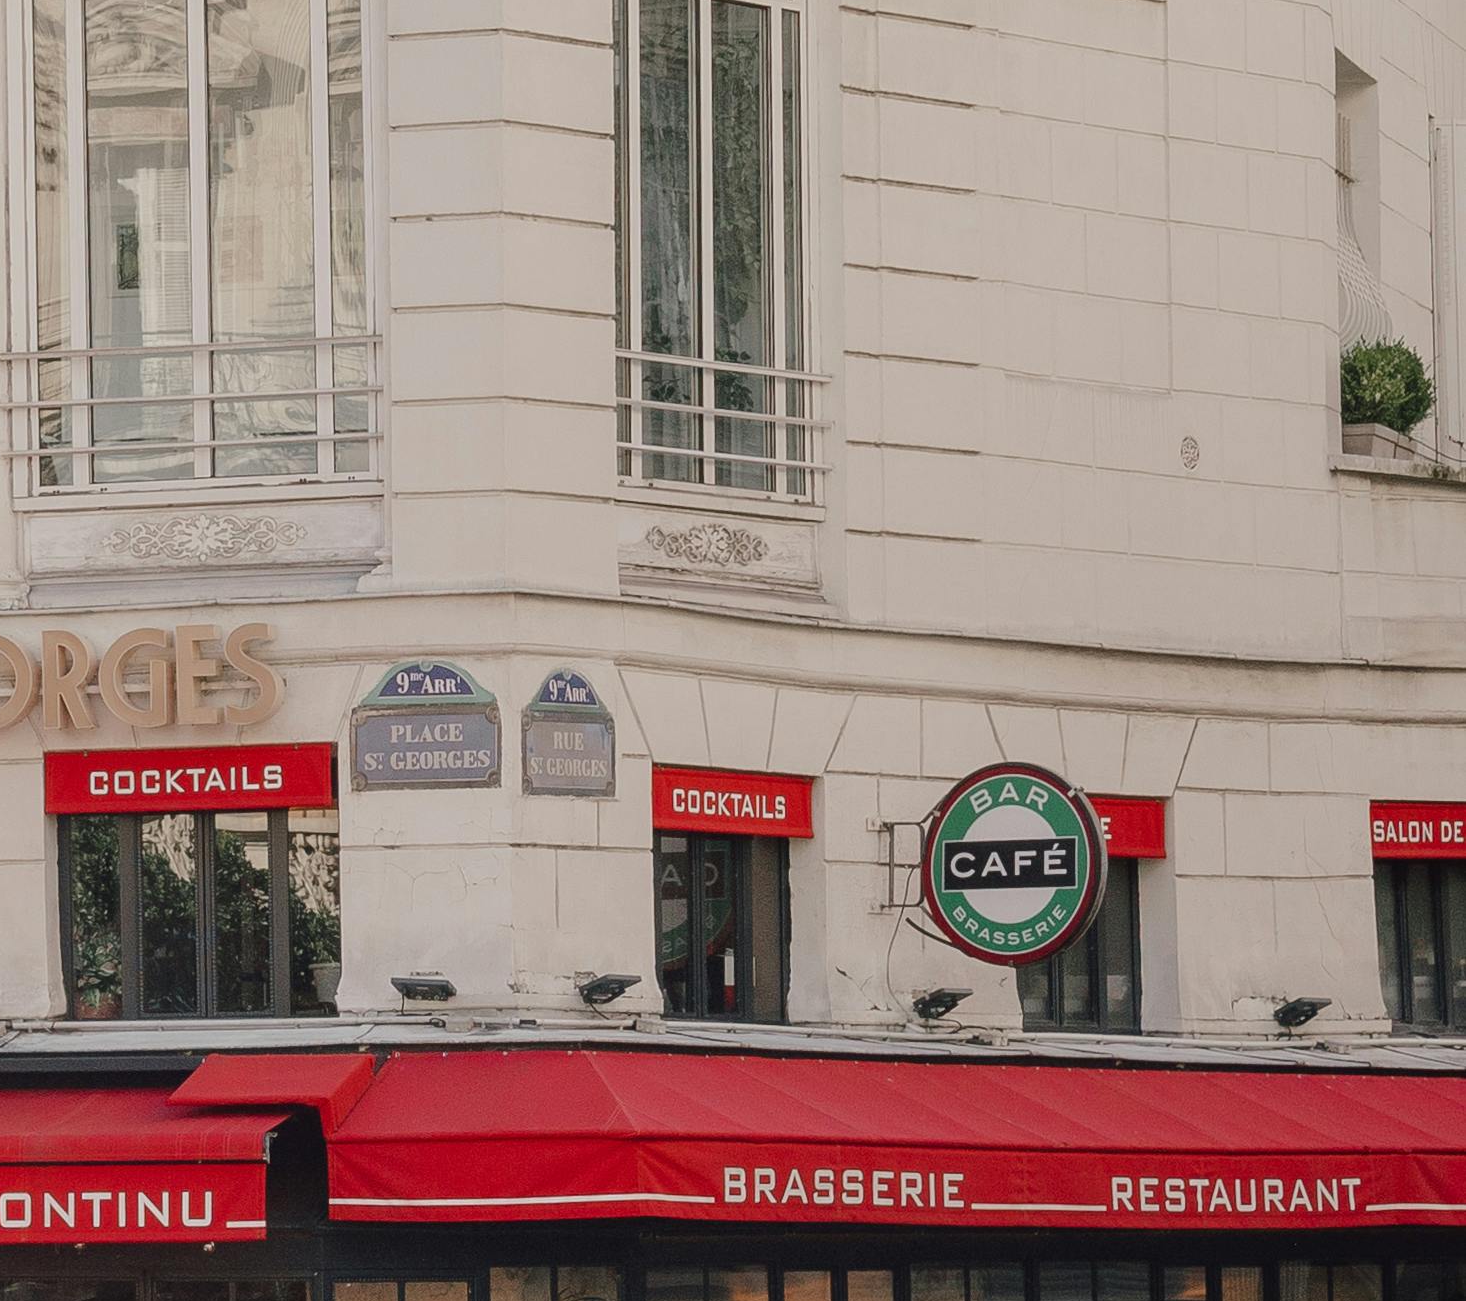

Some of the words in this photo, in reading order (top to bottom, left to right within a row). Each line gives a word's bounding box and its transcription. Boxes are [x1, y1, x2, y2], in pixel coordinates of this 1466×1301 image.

[390, 723, 464, 743] PLACE
[553, 731, 584, 751] RUE
[390, 750, 491, 770] GEORGES
[546, 758, 608, 778] GEORGES
[89, 764, 284, 796] COCKTAILS
[672, 788, 787, 820] COCKTAILS
[968, 782, 1049, 814] BAR
[1373, 819, 1434, 843] SALON
[1441, 820, 1465, 843] DE
[950, 843, 1068, 878] CAFÉ
[952, 903, 1067, 946] BRASSERIE
[724, 1166, 965, 1208] BRASSERIE
[1110, 1176, 1362, 1213] RESTAURANT
